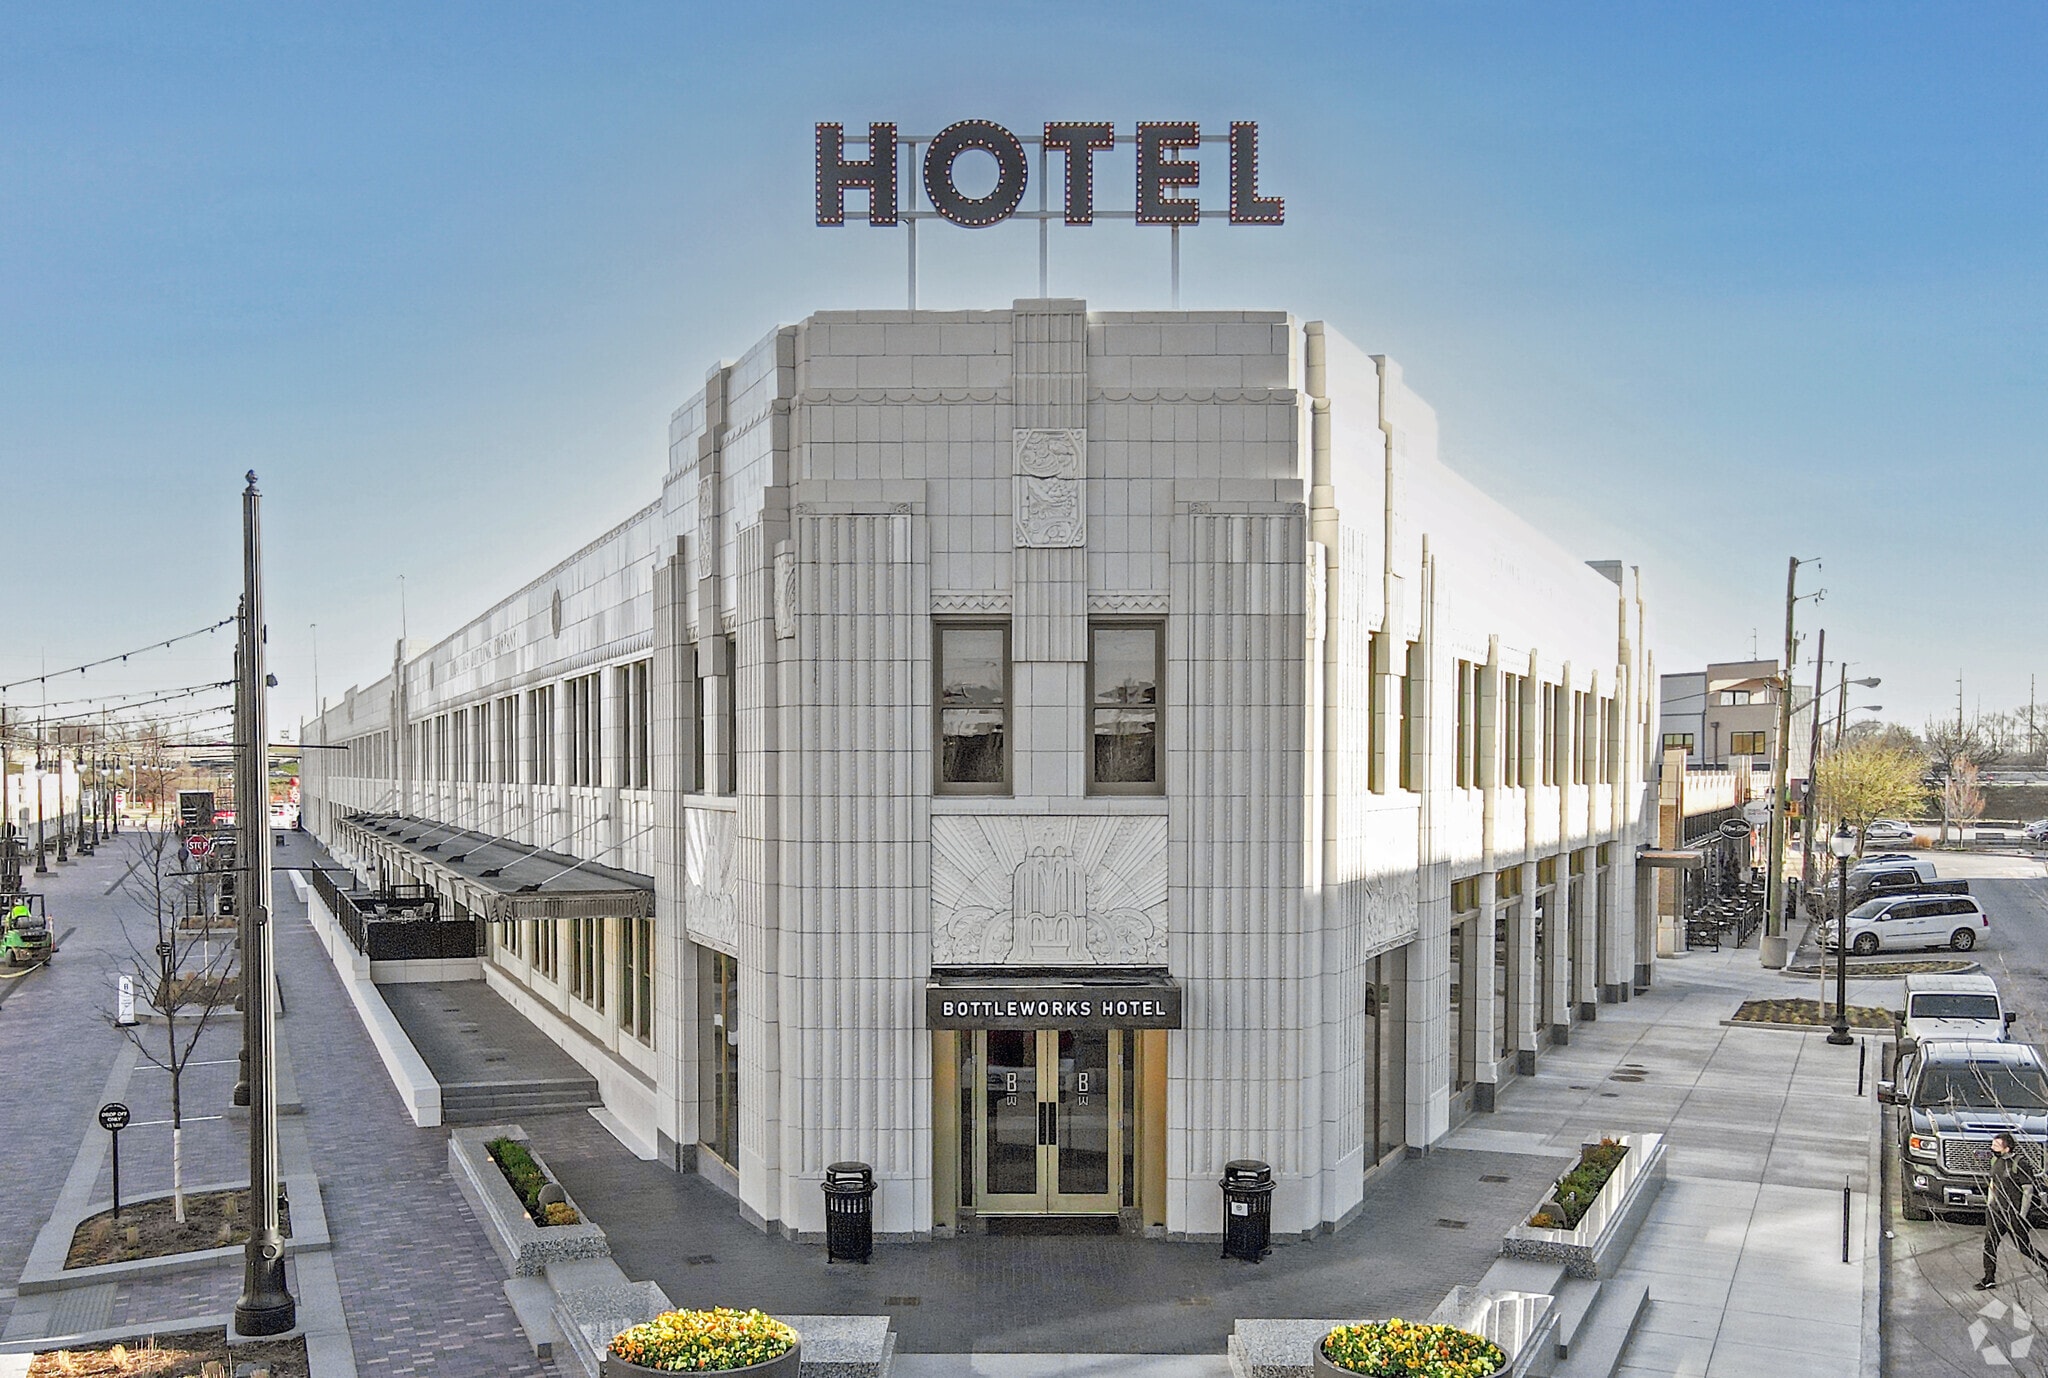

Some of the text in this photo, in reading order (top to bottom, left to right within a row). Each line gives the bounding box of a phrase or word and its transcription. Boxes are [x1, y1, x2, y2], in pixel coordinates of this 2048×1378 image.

[815, 119, 1285, 228] HOTEL
[942, 1001, 1167, 1017] BOTTLEWORKS HOTEL
